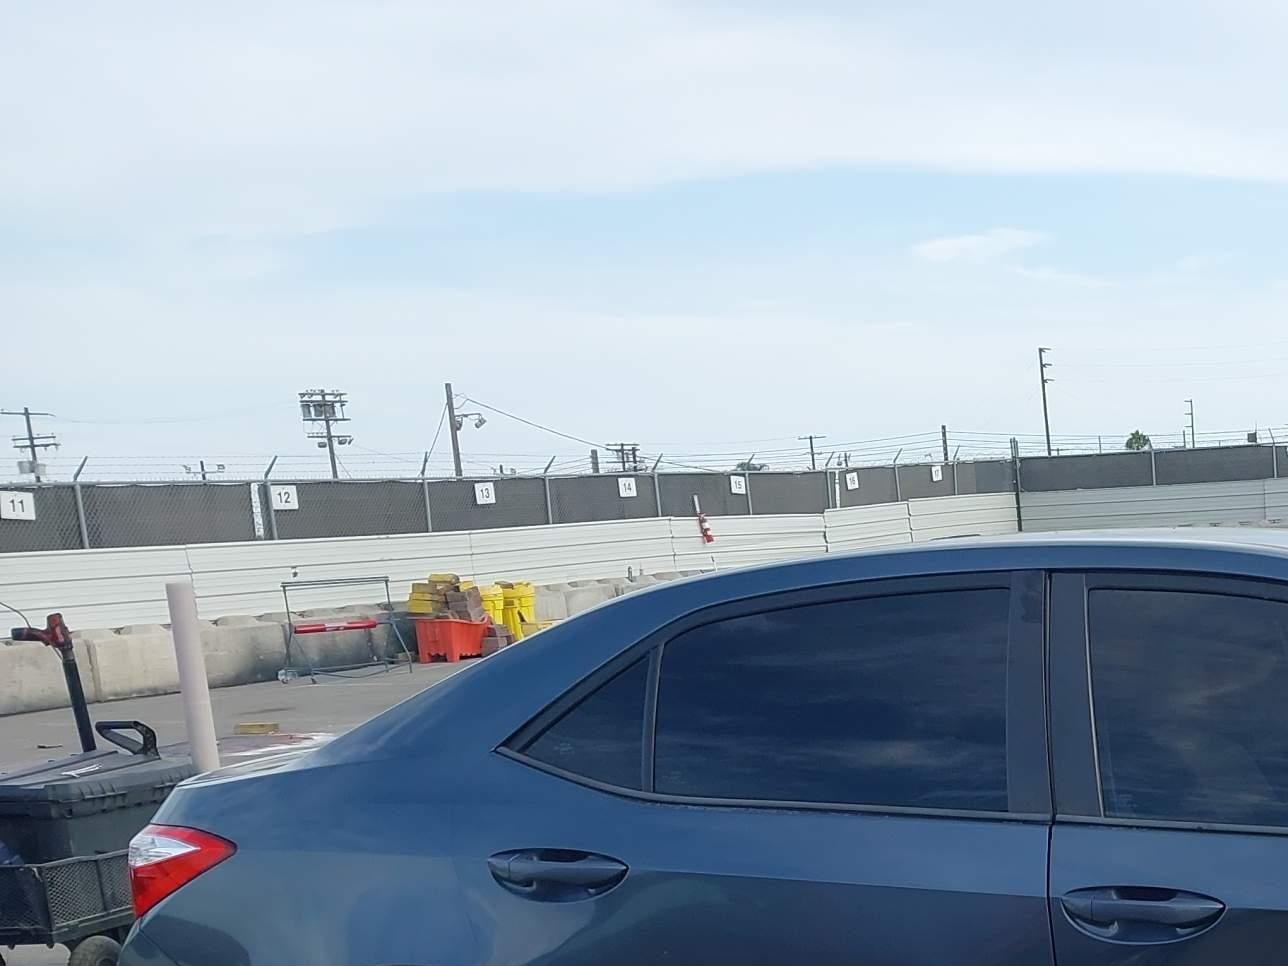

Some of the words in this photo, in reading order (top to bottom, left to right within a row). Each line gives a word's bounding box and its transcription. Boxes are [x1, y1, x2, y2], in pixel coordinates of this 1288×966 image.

[623, 482, 632, 493] 14
[734, 480, 742, 490] 15
[276, 491, 291, 504] 12
[480, 487, 490, 499] 13
[9, 499, 25, 513] 11
